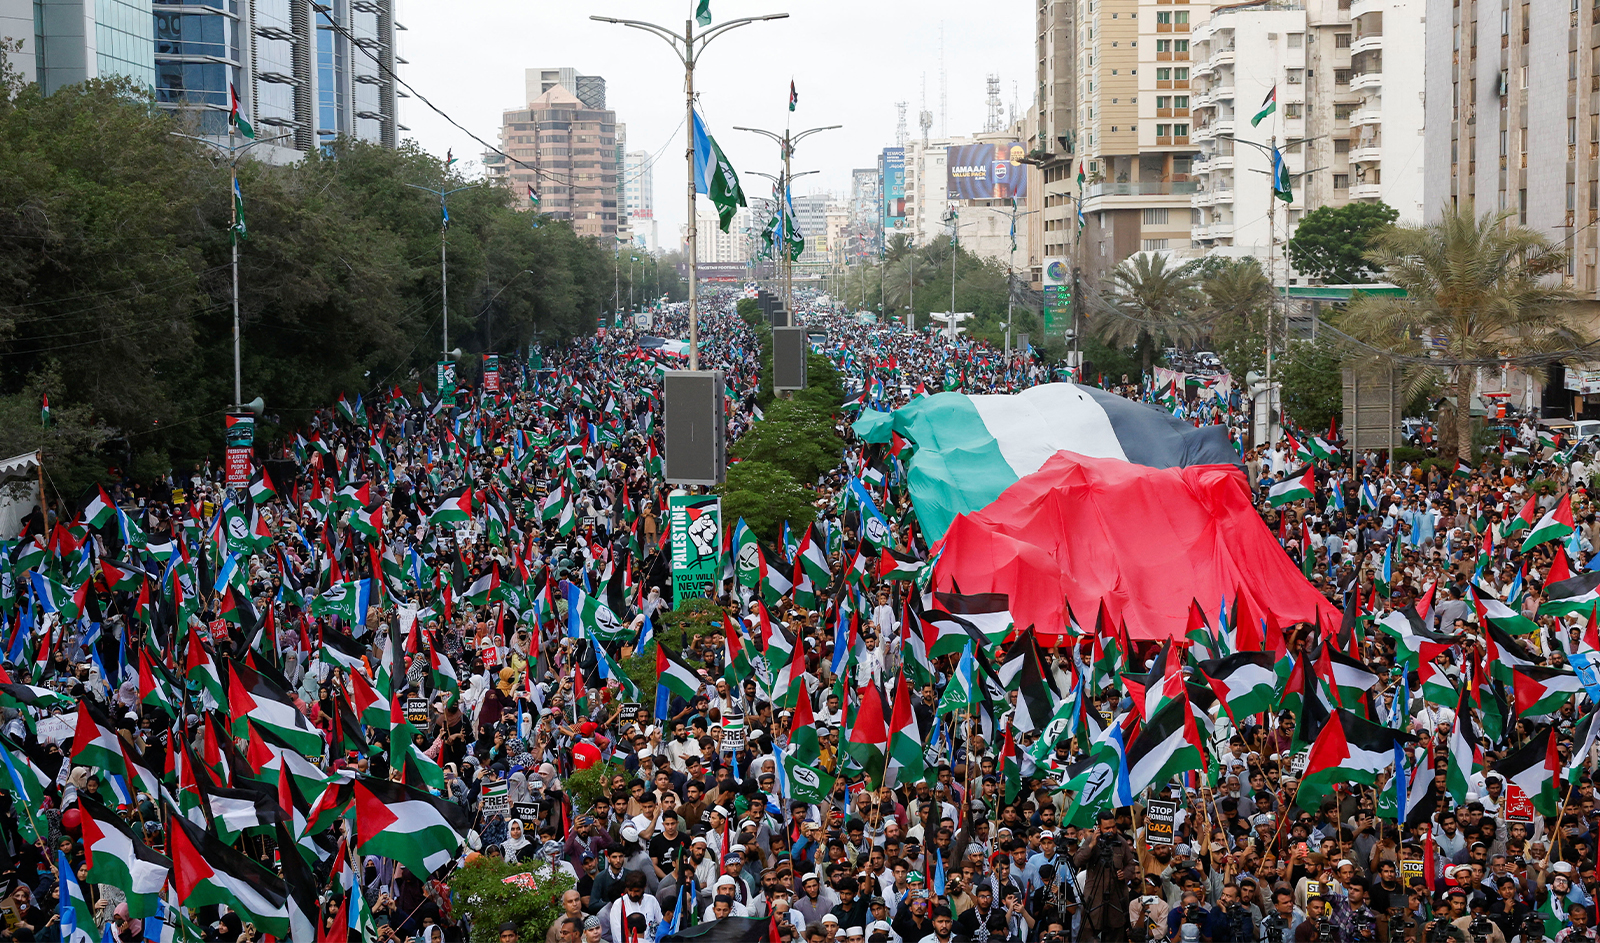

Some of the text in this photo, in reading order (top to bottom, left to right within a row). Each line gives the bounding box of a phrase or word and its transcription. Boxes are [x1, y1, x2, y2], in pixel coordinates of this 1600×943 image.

[672, 505, 687, 570] PALESTINE
[679, 582, 705, 591] NEVE
[482, 795, 508, 805] FREE
[1150, 806, 1172, 815] STOP
[524, 822, 534, 830] ZA
[1148, 822, 1172, 833] GAZA
[1403, 863, 1423, 871] STOP
[1309, 884, 1319, 892] ST
